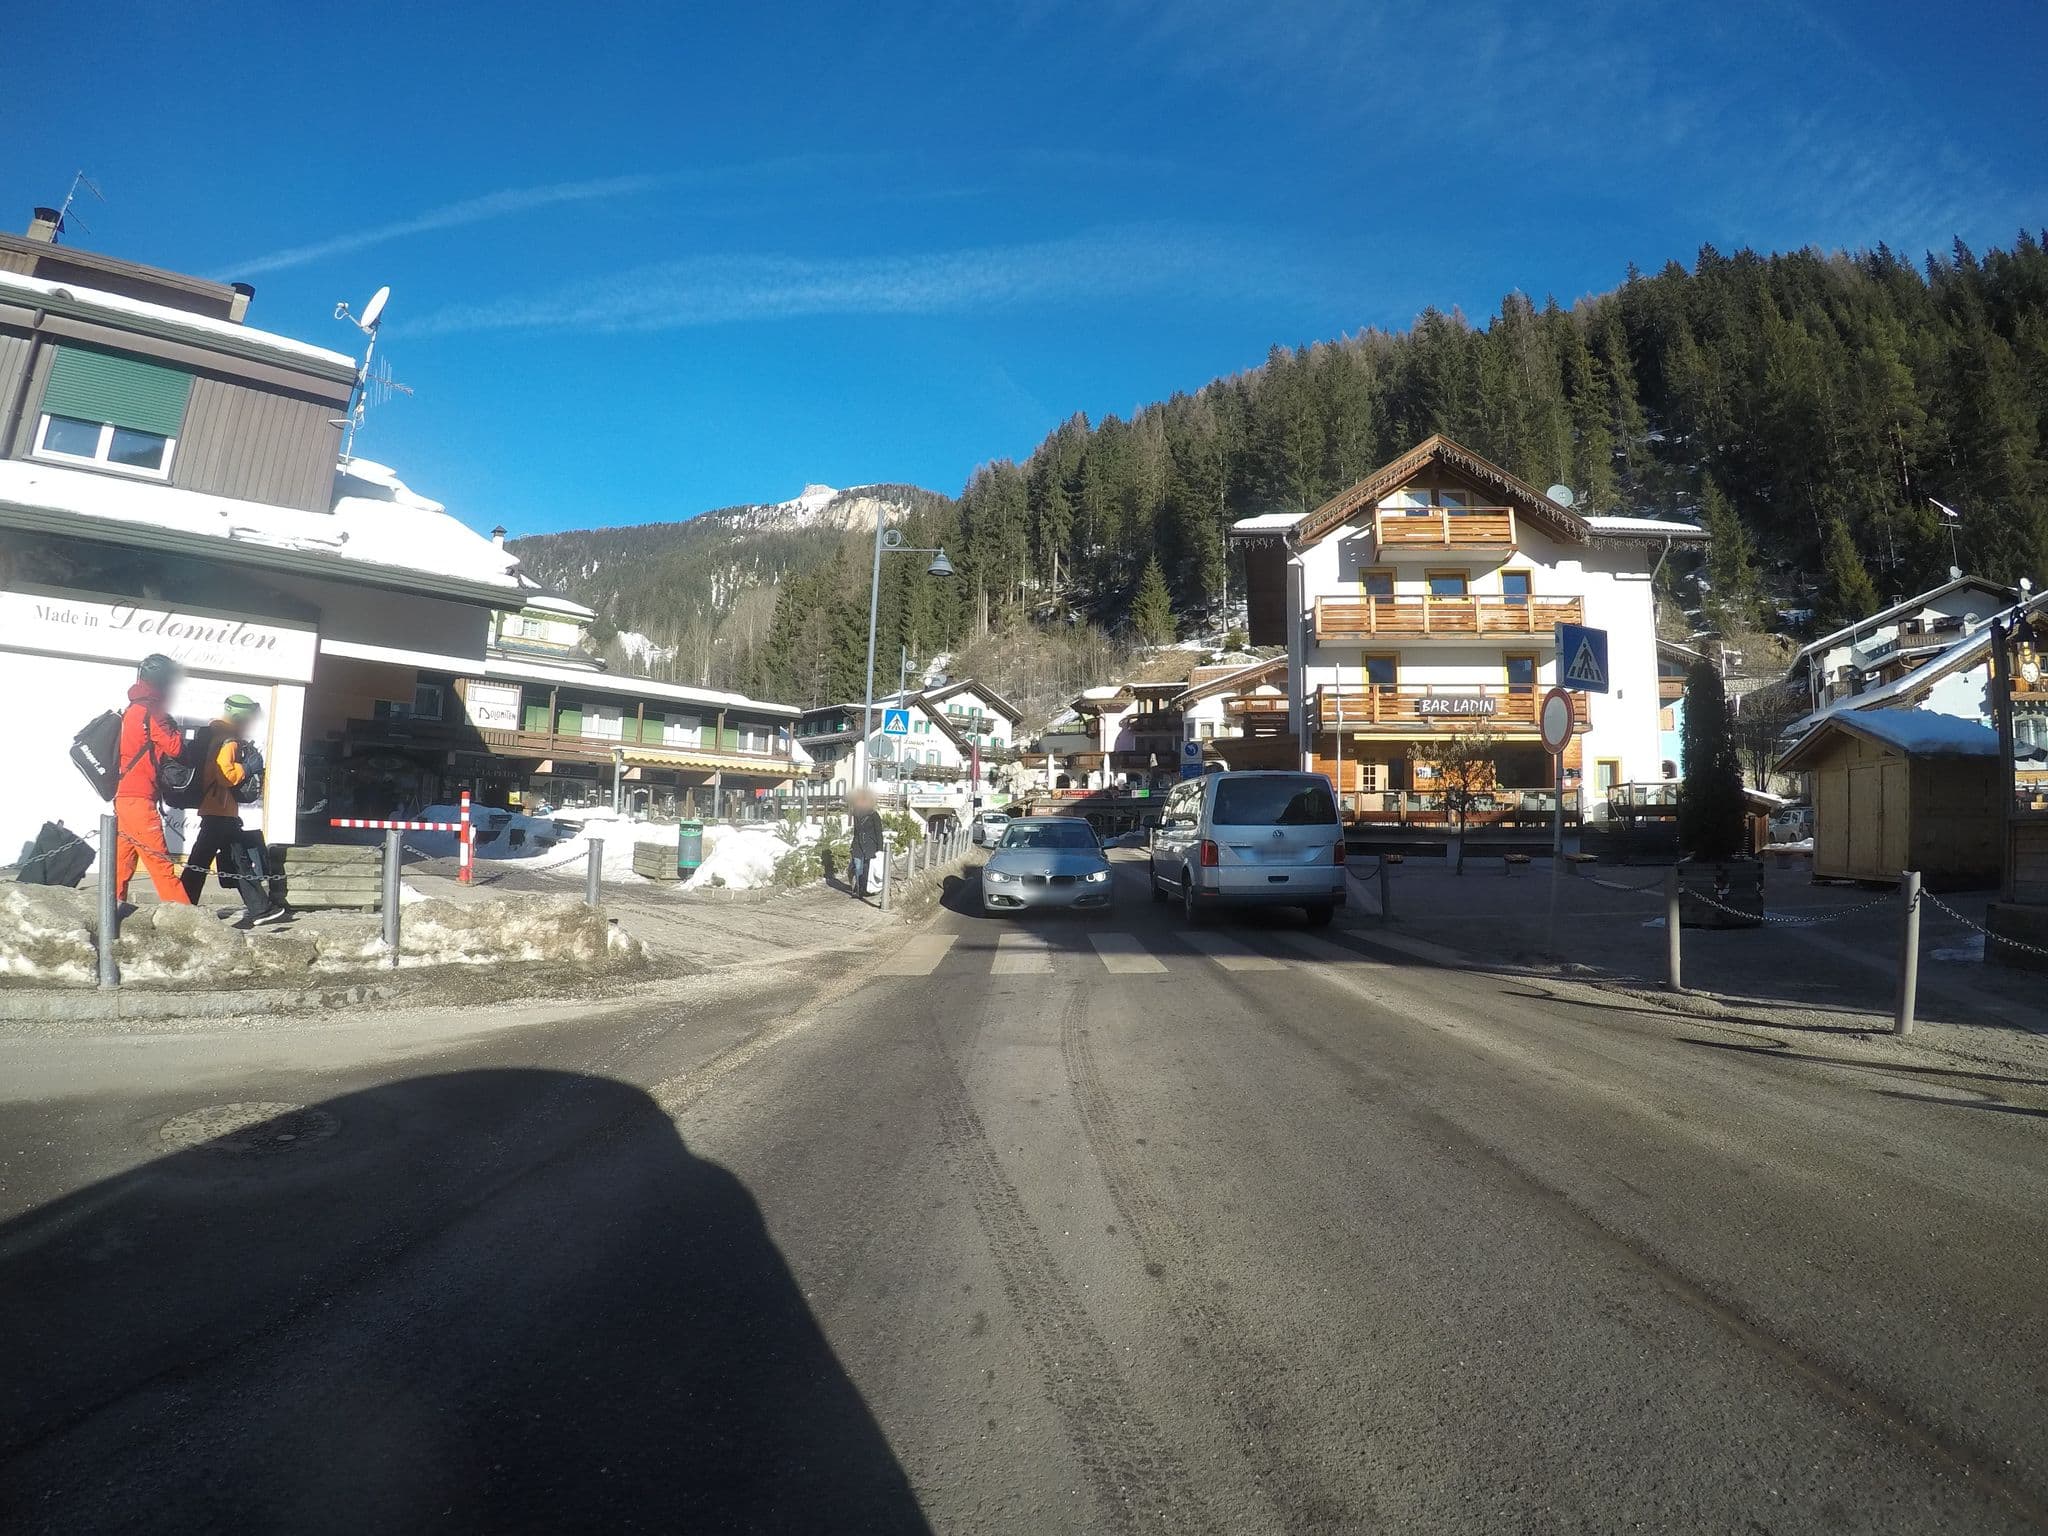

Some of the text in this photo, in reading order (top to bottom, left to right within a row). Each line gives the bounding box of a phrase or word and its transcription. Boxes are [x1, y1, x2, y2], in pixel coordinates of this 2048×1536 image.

[35, 605, 79, 625] Made
[85, 611, 98, 627] in
[1422, 699, 1494, 713] BAR LADIN
